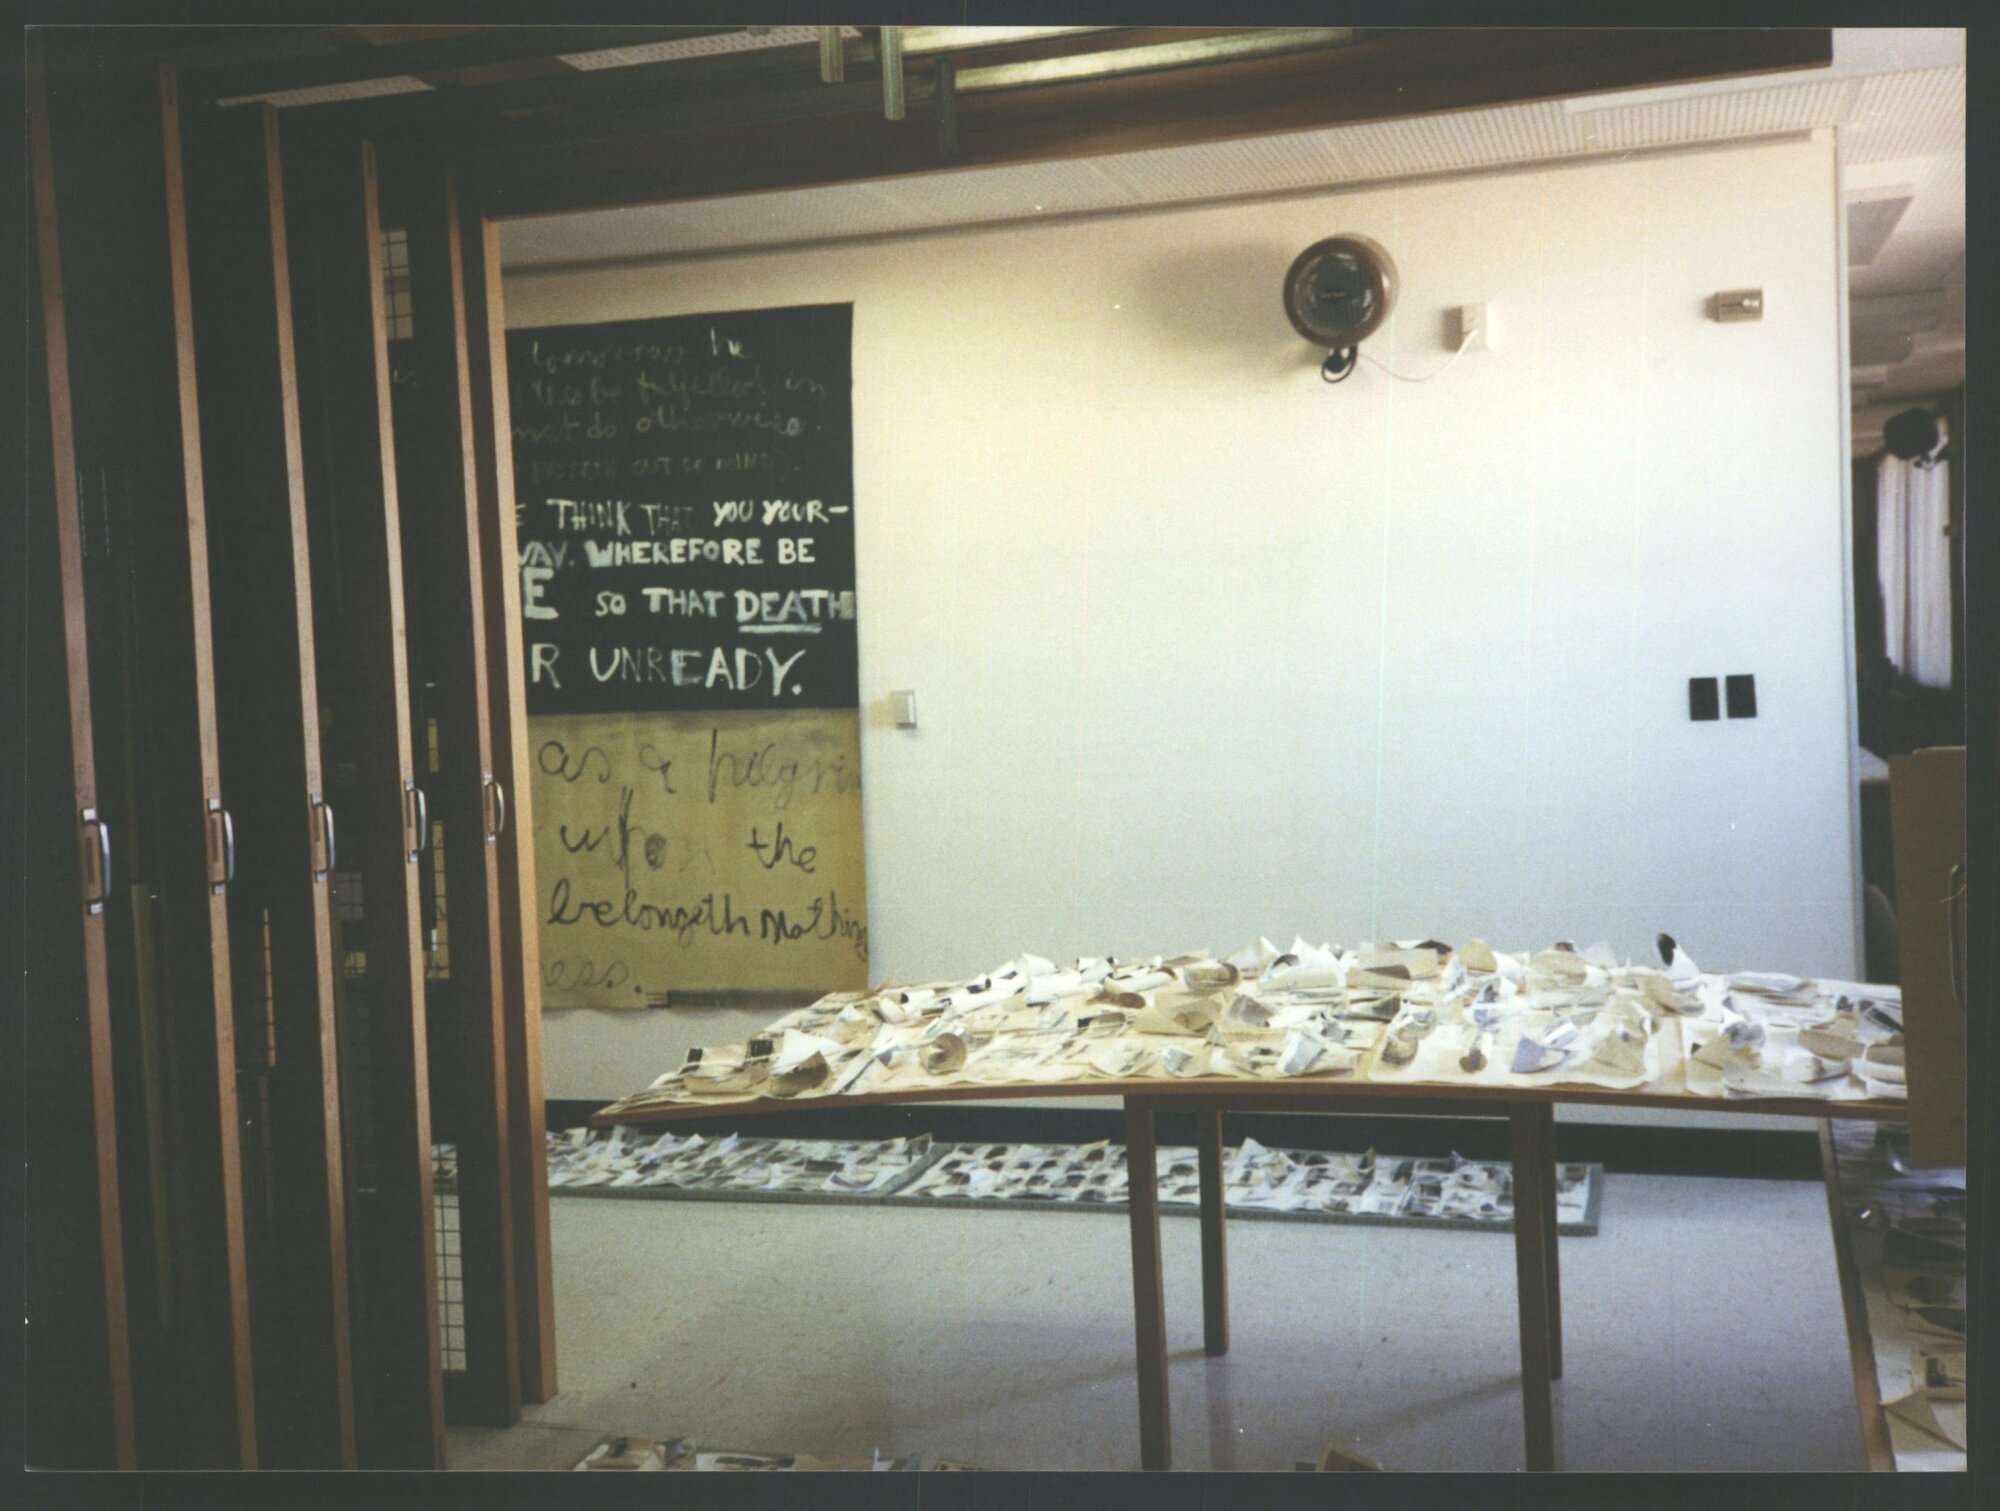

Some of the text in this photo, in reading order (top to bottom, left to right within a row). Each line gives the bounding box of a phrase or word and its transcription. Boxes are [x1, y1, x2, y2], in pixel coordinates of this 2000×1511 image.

[546, 498, 632, 535] THINK
[640, 503, 695, 536] THAT
[713, 501, 754, 527] YOU
[584, 538, 765, 567] WHEREFORE
[777, 538, 816, 565] BE
[595, 591, 627, 617] SO
[641, 588, 726, 617] THAT
[734, 589, 857, 632] DEATH
[590, 647, 806, 696] UNREADY.
[538, 741, 612, 783] as
[748, 822, 817, 873] the
